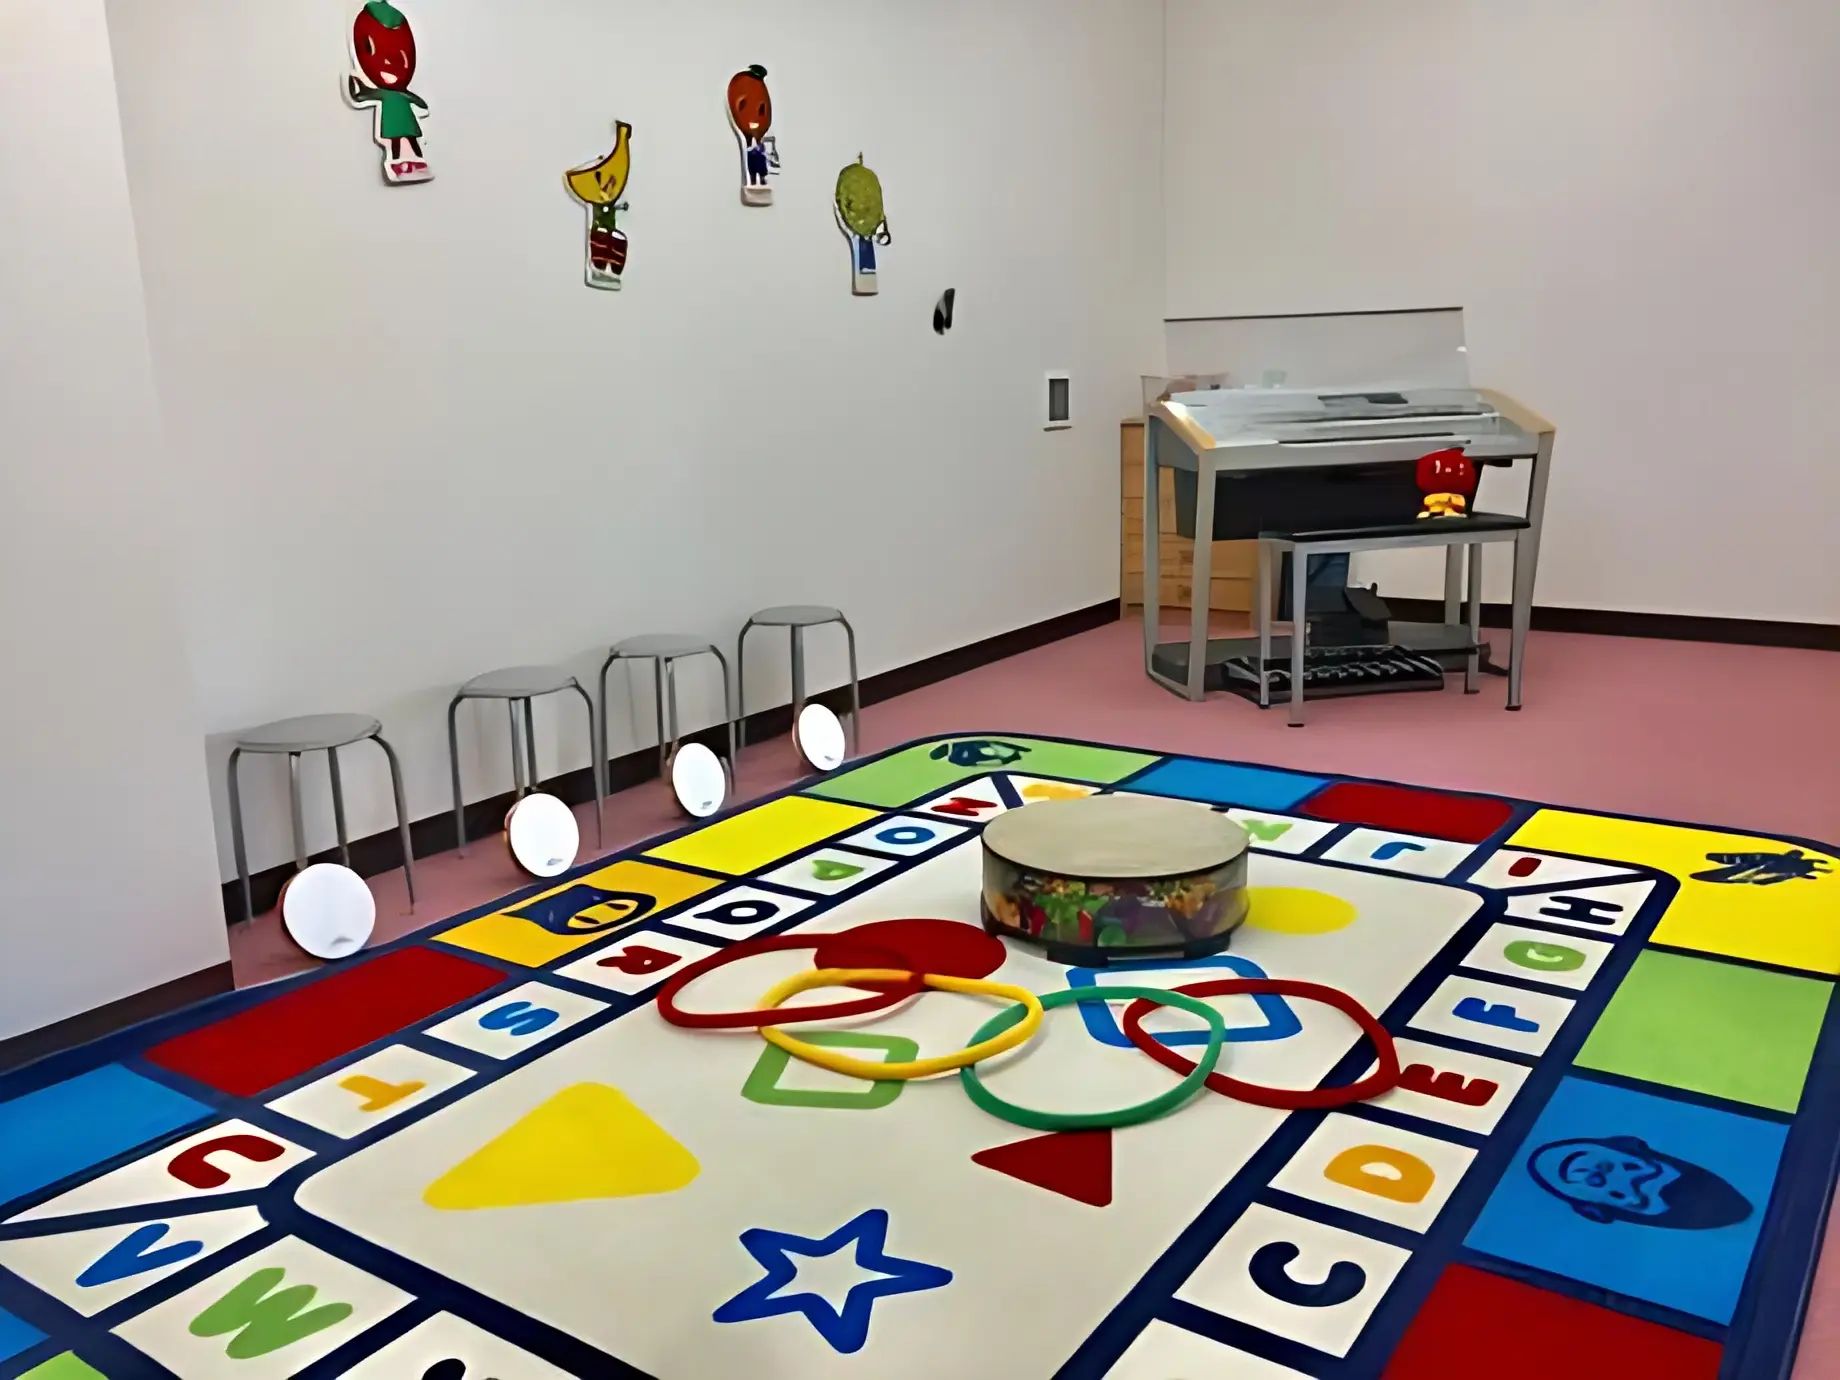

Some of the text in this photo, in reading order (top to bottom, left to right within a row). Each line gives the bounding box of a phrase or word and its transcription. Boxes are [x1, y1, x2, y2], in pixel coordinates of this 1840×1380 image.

[694, 898, 780, 925] Q
[1539, 895, 1624, 926] H
[596, 945, 683, 976] R
[478, 1001, 560, 1036] S
[1452, 997, 1540, 1033] F
[338, 1074, 426, 1112] T
[1400, 1063, 1499, 1107] E
[167, 1134, 286, 1189] U
[1323, 1144, 1436, 1204] D
[75, 1222, 204, 1288] V
[1248, 1241, 1367, 1307] C
[188, 1267, 354, 1360] W
